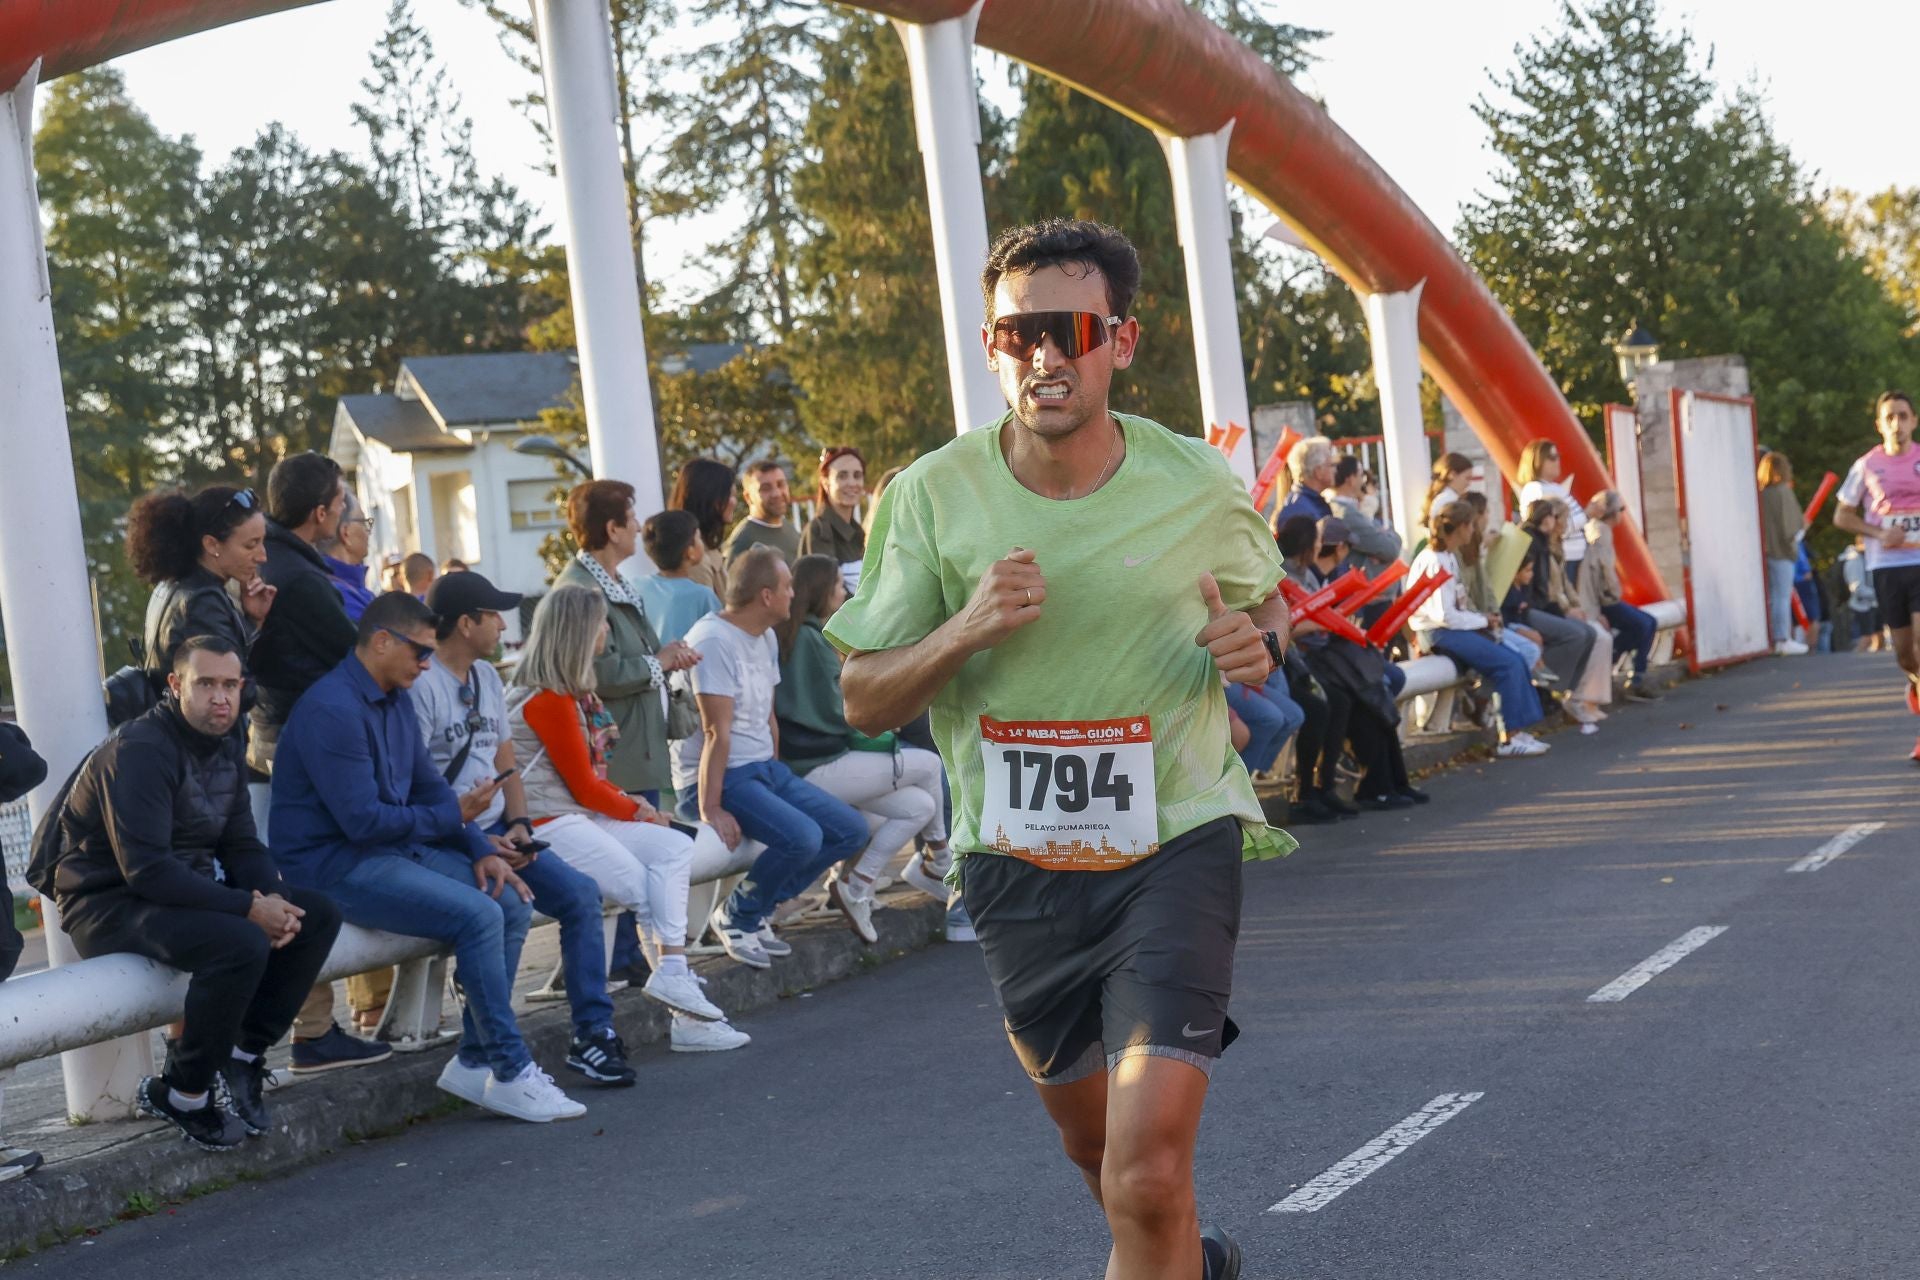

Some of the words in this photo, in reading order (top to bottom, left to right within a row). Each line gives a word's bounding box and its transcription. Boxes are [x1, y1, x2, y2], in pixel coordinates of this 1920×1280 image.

[1026, 728, 1059, 739] MBA
[1087, 726, 1123, 739] GIJÓN
[1002, 750, 1133, 813] 1794
[1025, 824, 1056, 832] PELAYO
[1057, 824, 1111, 832] PUMARIEGA
